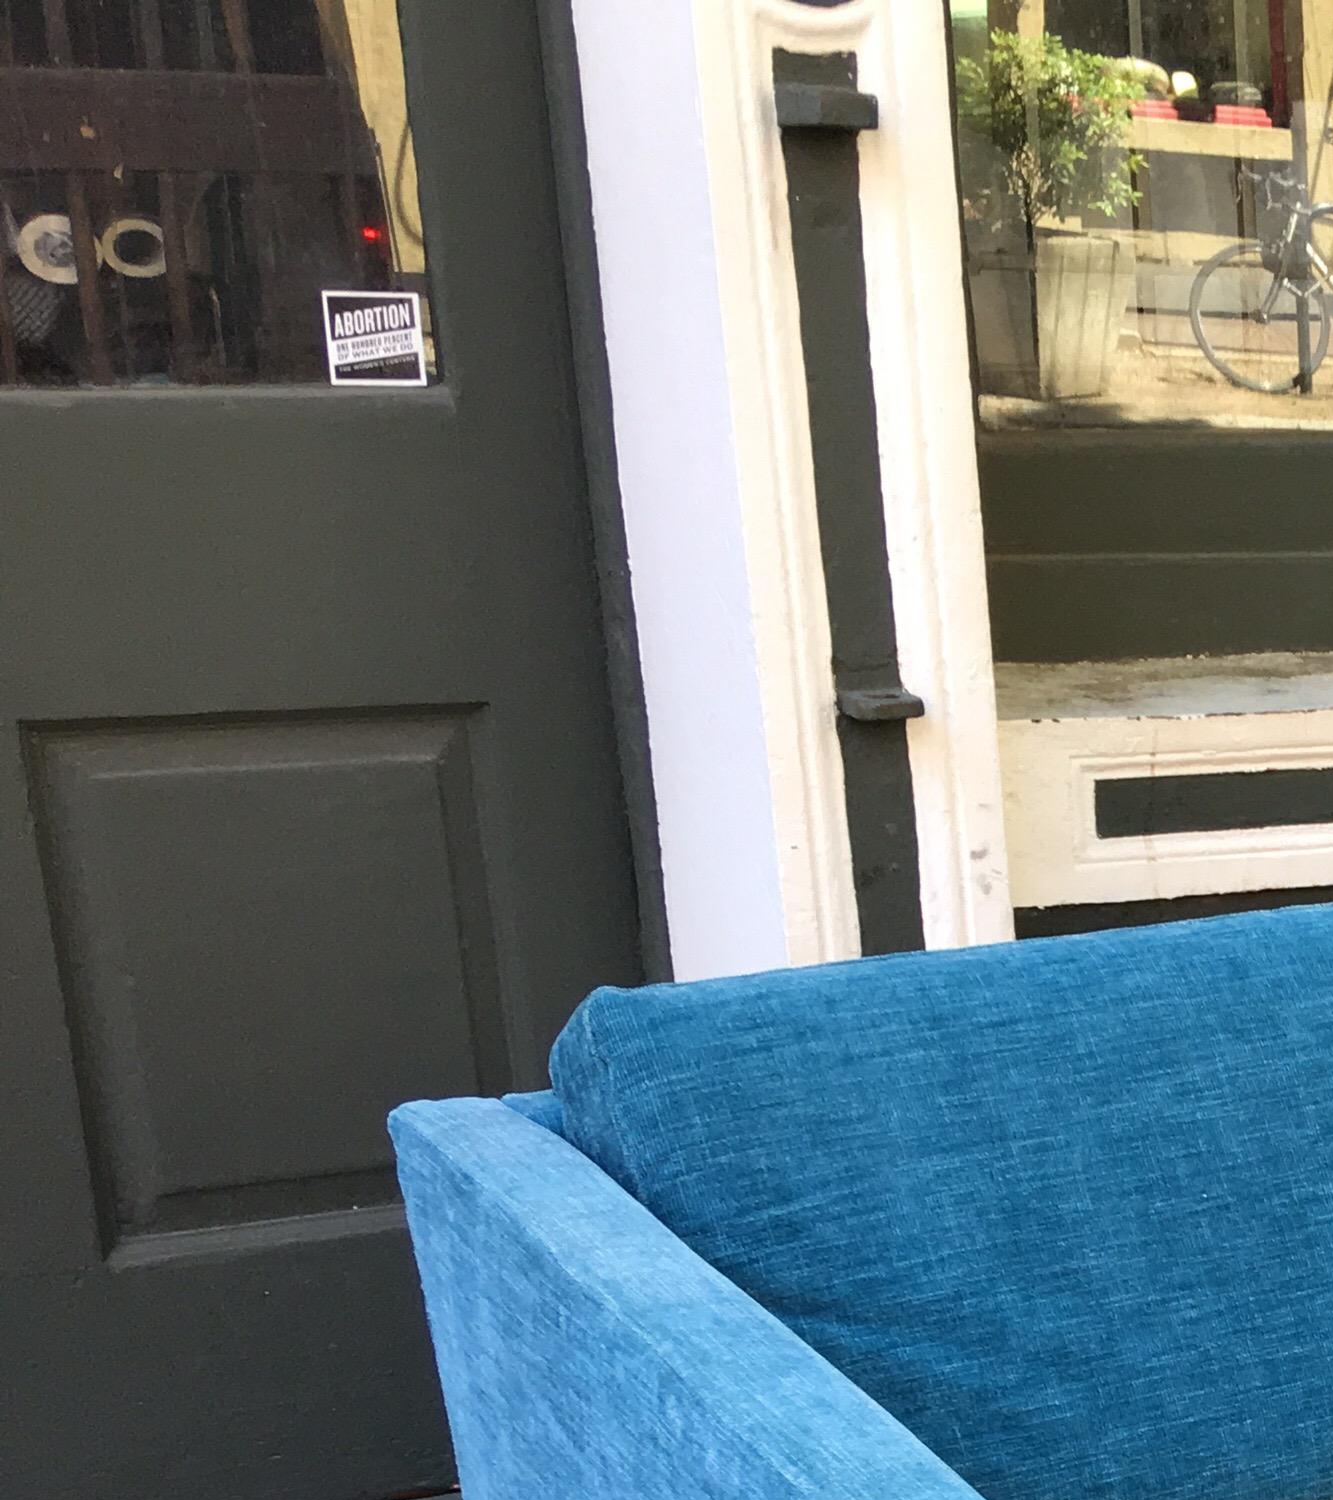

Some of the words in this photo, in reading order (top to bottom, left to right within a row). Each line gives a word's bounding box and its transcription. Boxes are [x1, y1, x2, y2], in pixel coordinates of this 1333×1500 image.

[334, 303, 411, 338] ABORTION
[337, 342, 349, 353] ONE
[351, 337, 382, 351] HUNDRED
[383, 332, 412, 346] PERCENT
[338, 352, 349, 360] OF
[352, 347, 381, 358] WHAT
[383, 345, 398, 354] WE
[400, 343, 413, 351] DO
